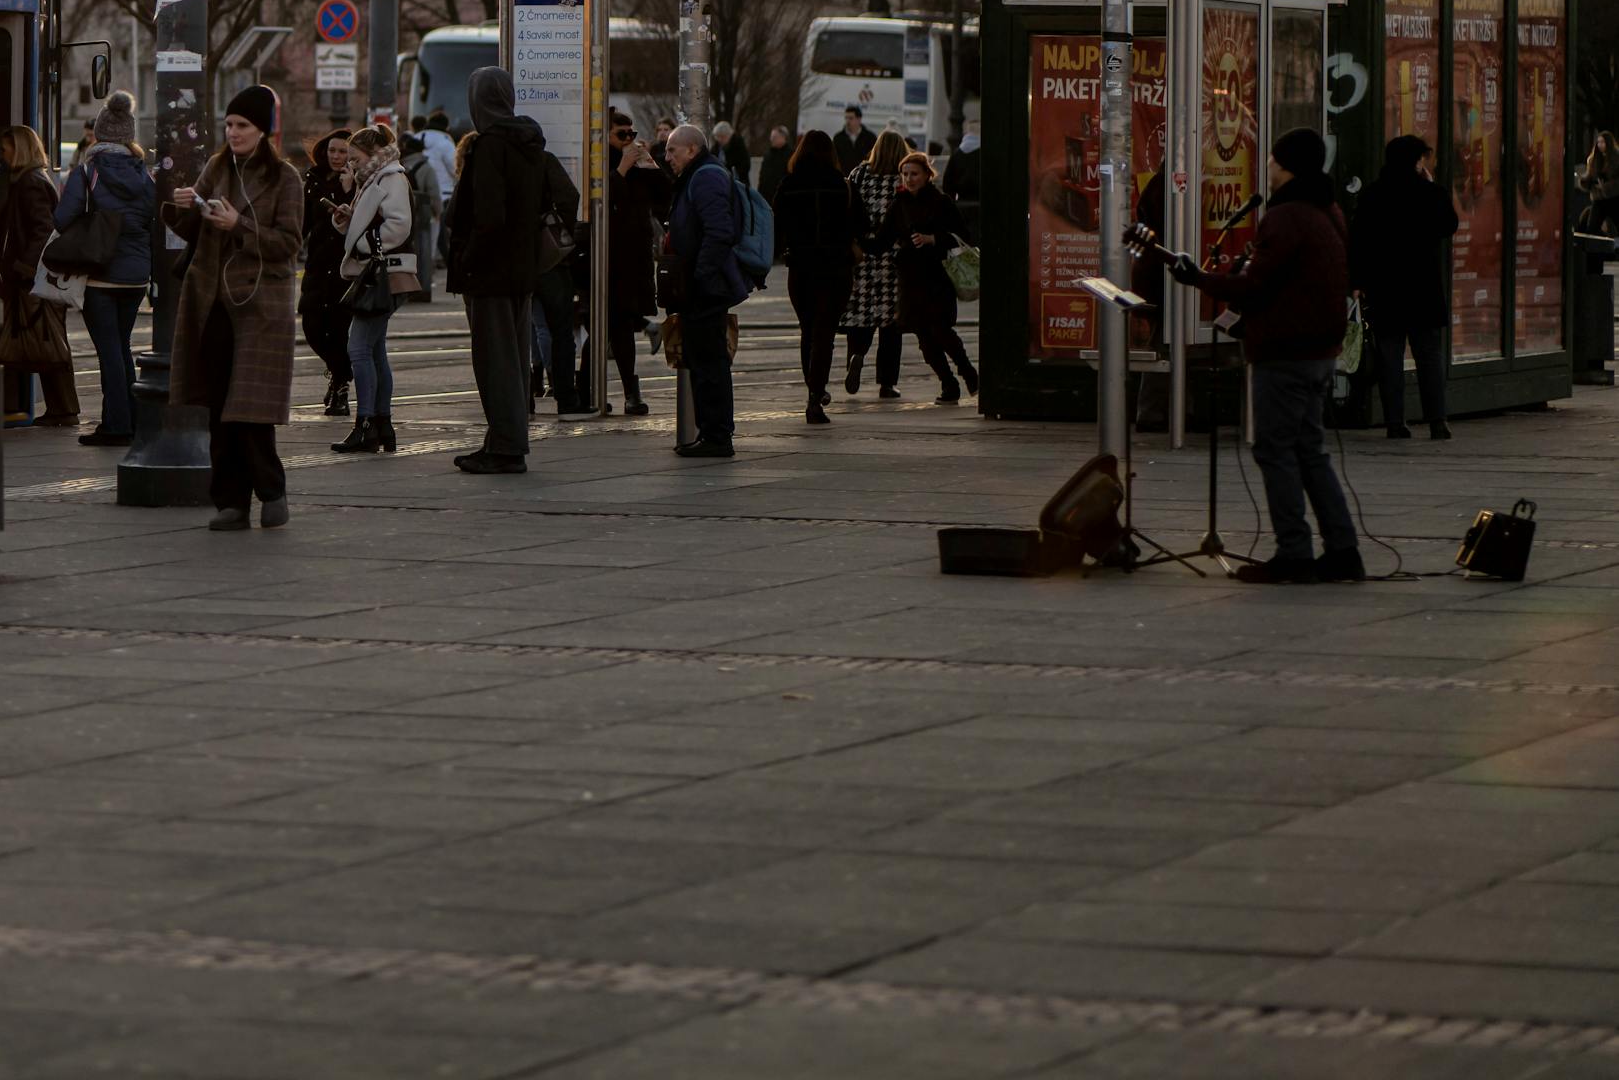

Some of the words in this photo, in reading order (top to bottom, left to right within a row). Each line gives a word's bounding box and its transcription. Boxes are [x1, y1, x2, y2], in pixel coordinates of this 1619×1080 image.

[518, 10, 525, 22] 2
[526, 8, 582, 21] Črnomerec
[517, 30, 524, 41] 4
[526, 29, 553, 40] Savski
[554, 30, 580, 40] most
[517, 48, 524, 61] 6
[526, 48, 582, 61] Črnomerec
[519, 69, 527, 81] 9
[527, 69, 578, 82] Ljubljanica
[517, 88, 527, 101] 13
[528, 87, 560, 102] Žitnjak
[1042, 77, 1101, 101] PAKET
[1048, 317, 1087, 329] TISAK
[1048, 329, 1086, 341] PAKET
